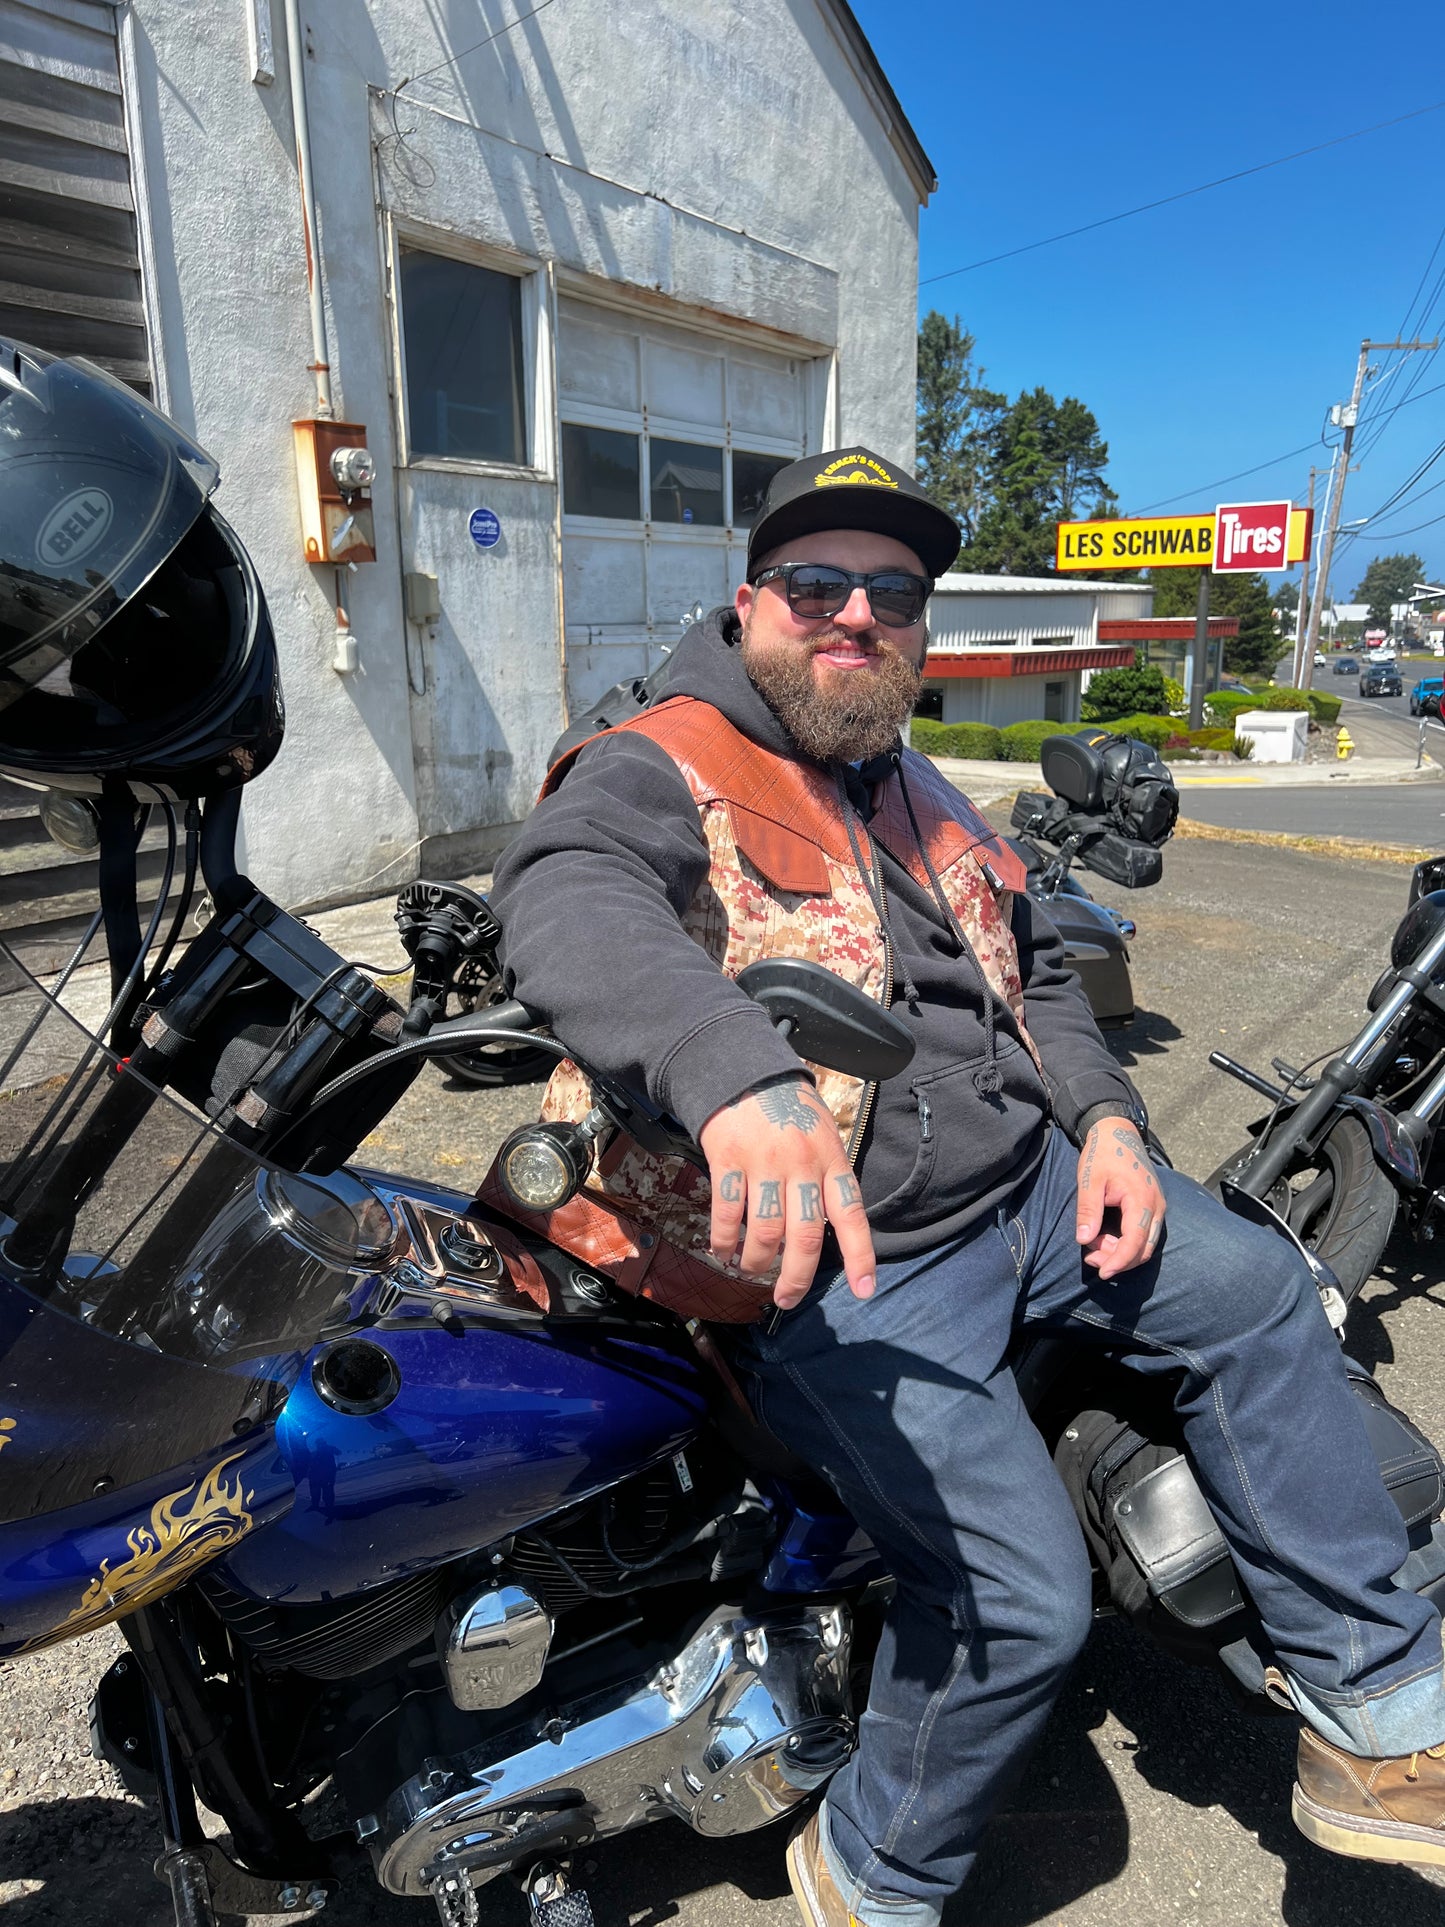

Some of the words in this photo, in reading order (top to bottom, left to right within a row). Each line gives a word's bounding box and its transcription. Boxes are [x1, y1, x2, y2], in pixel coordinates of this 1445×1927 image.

[867, 460, 891, 481] SHOP
[46, 501, 104, 556] BELL
[1065, 533, 1103, 558] LES
[1113, 528, 1212, 556] SCHWAB
[1221, 513, 1283, 564] Tires
[719, 1169, 863, 1221] CARE
